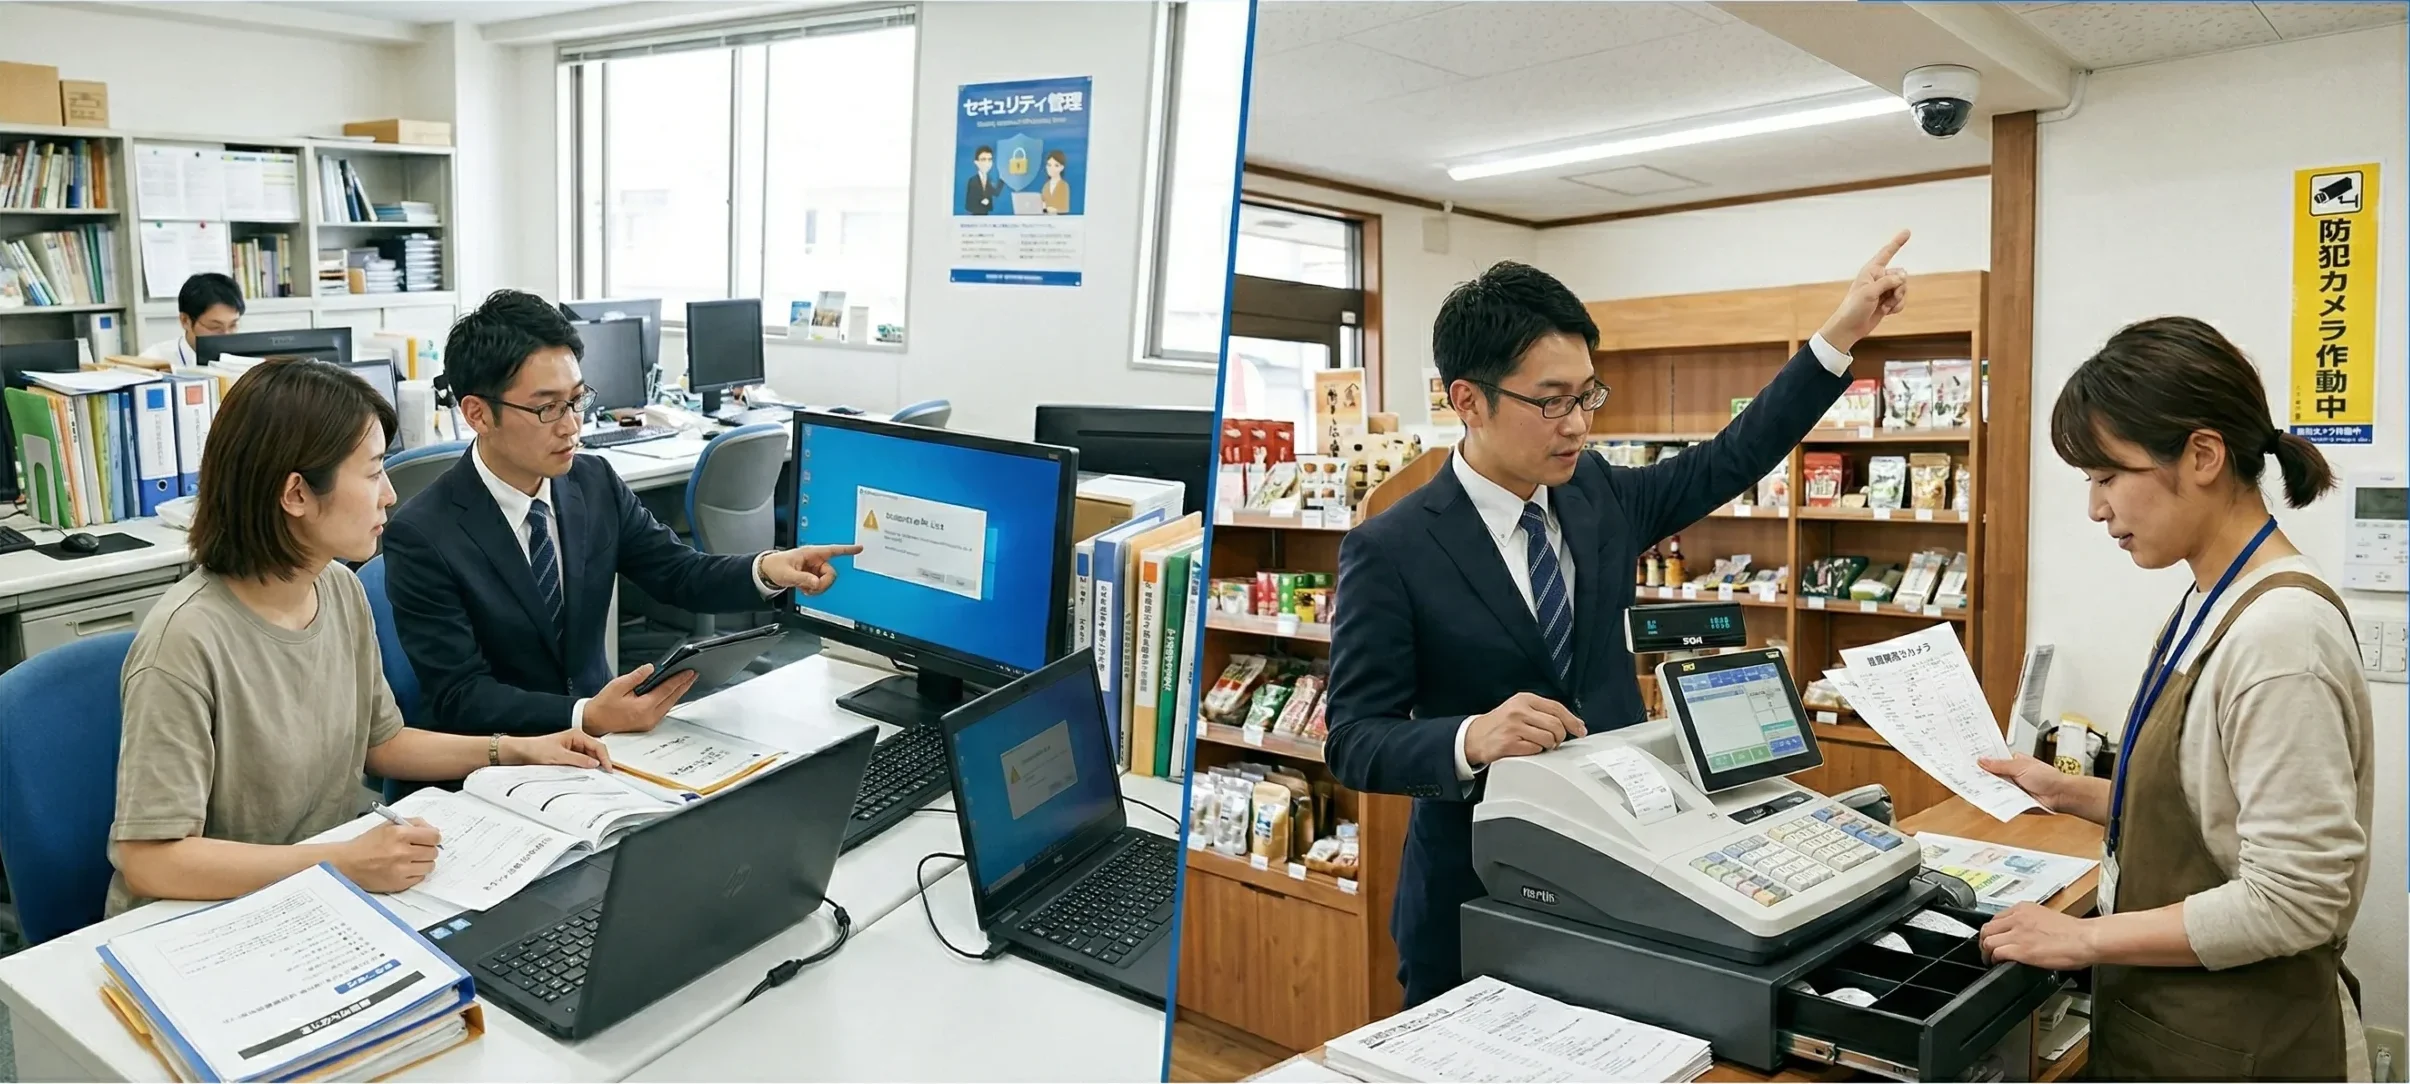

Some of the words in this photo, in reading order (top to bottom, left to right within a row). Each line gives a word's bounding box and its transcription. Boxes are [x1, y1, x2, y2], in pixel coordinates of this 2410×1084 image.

[963, 91, 1084, 116] セキュリティ管理
[2315, 218, 2351, 419] 防犯カメラ作動中
